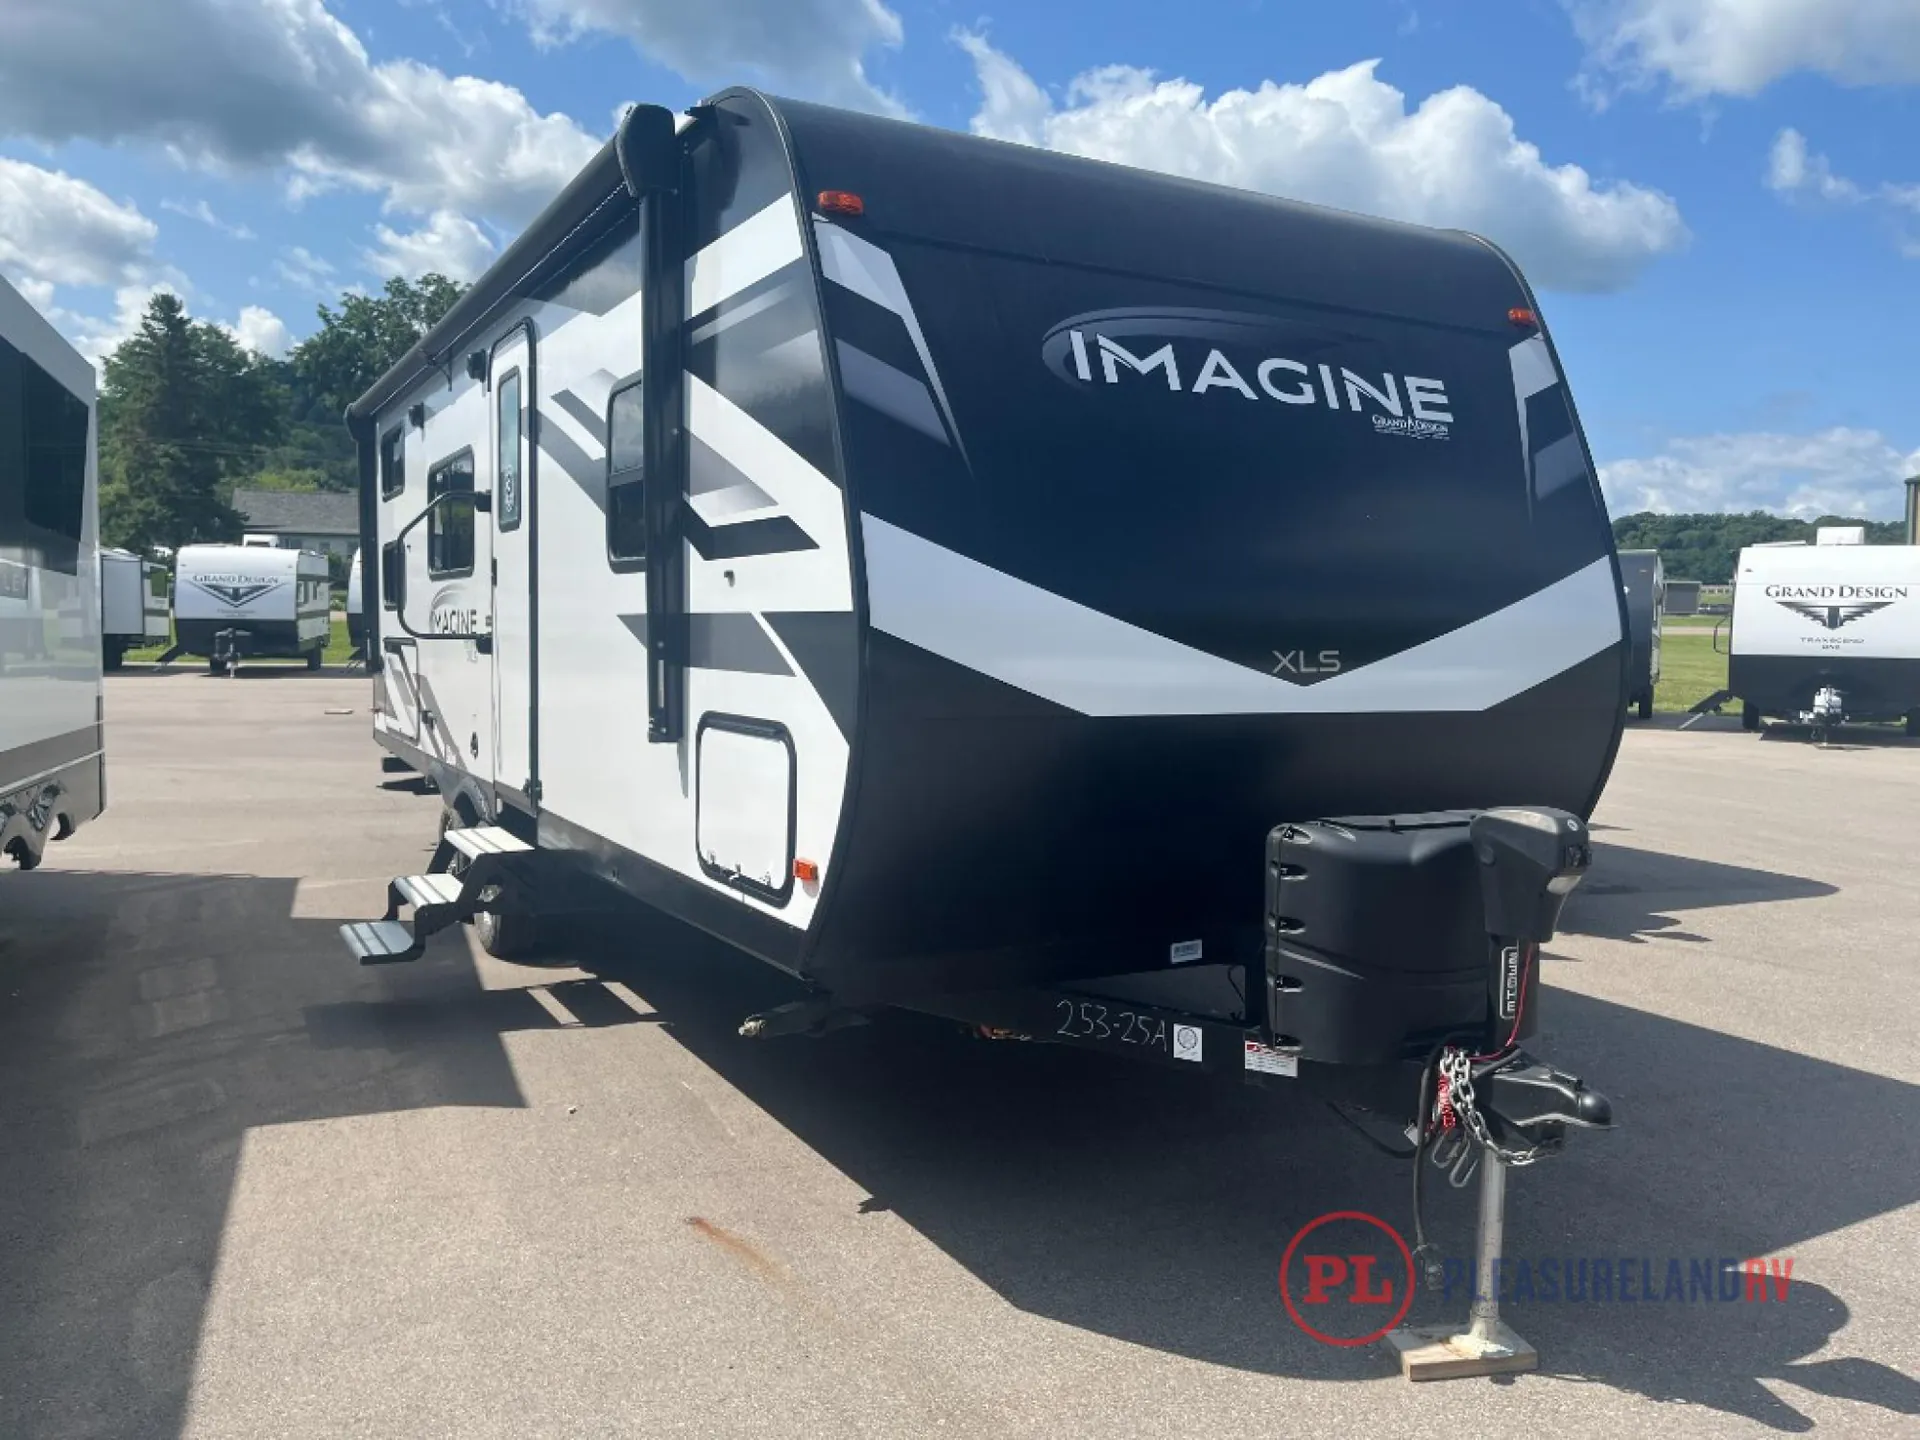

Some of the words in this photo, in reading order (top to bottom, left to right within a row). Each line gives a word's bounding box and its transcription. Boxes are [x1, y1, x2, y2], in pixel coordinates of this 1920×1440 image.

[1070, 329, 1454, 422] IMAGINE
[1765, 584, 1835, 598] GRAND
[1838, 584, 1909, 599] DESIGN
[1271, 649, 1341, 674] XLS
[1056, 999, 1168, 1053] 253-25A
